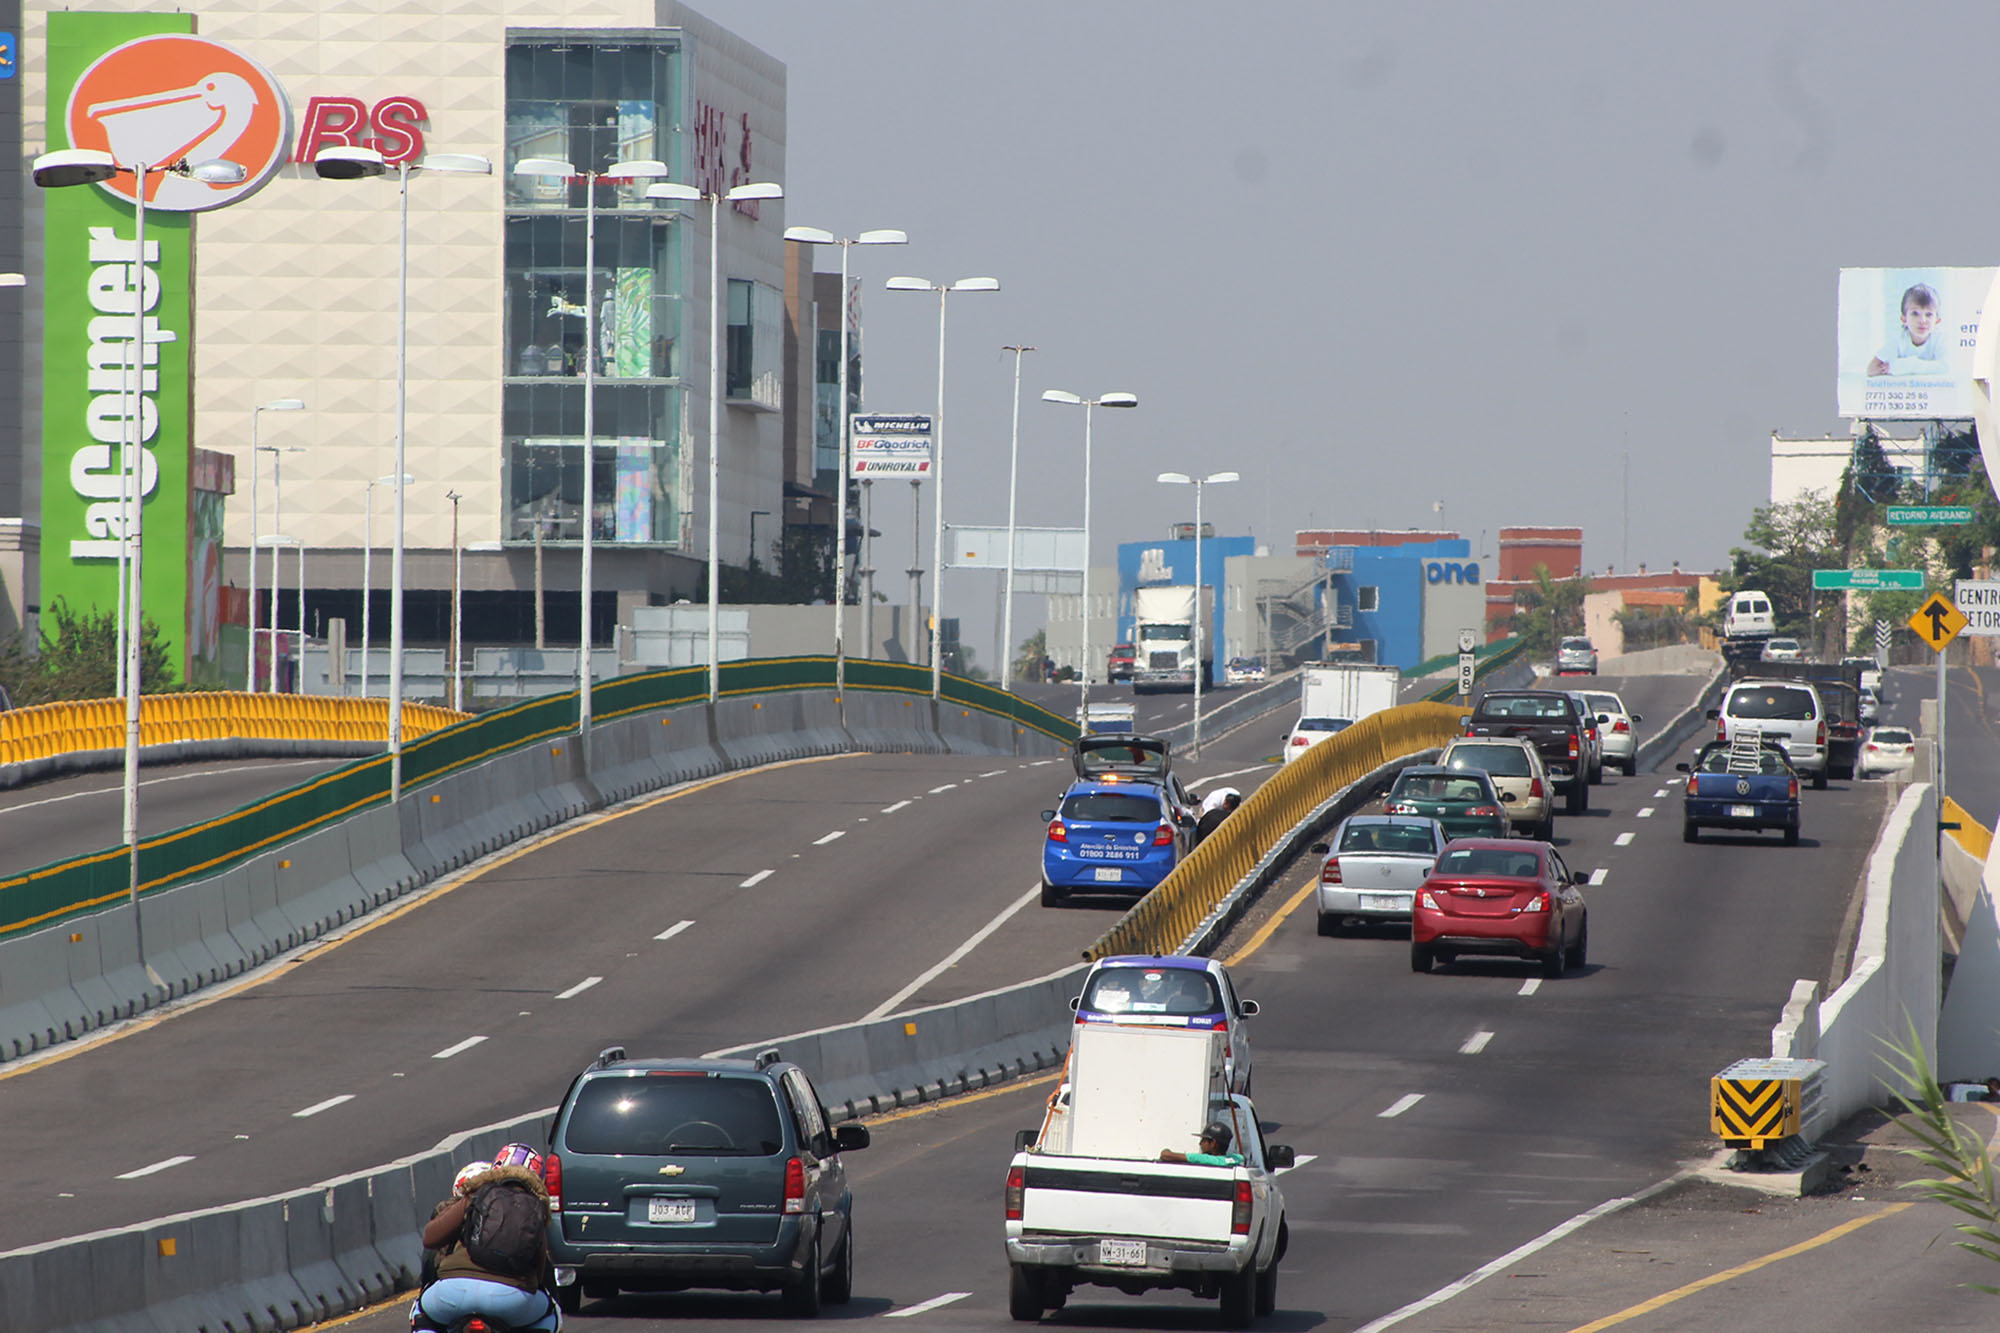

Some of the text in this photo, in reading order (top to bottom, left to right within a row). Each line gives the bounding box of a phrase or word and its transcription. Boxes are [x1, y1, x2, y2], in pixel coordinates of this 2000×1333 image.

[287, 96, 429, 165] RS
[873, 422, 930, 430] MICHELIN
[856, 439, 931, 449] BFGoodrich
[866, 461, 918, 472] UNIROYAL
[1889, 510, 1972, 520] RETORNO AVERANDA
[1426, 561, 1480, 586] one
[1960, 588, 2000, 606] CENTR
[1961, 610, 2000, 628] ETOR
[1080, 850, 1104, 858] 01800
[1125, 851, 1139, 859] 911
